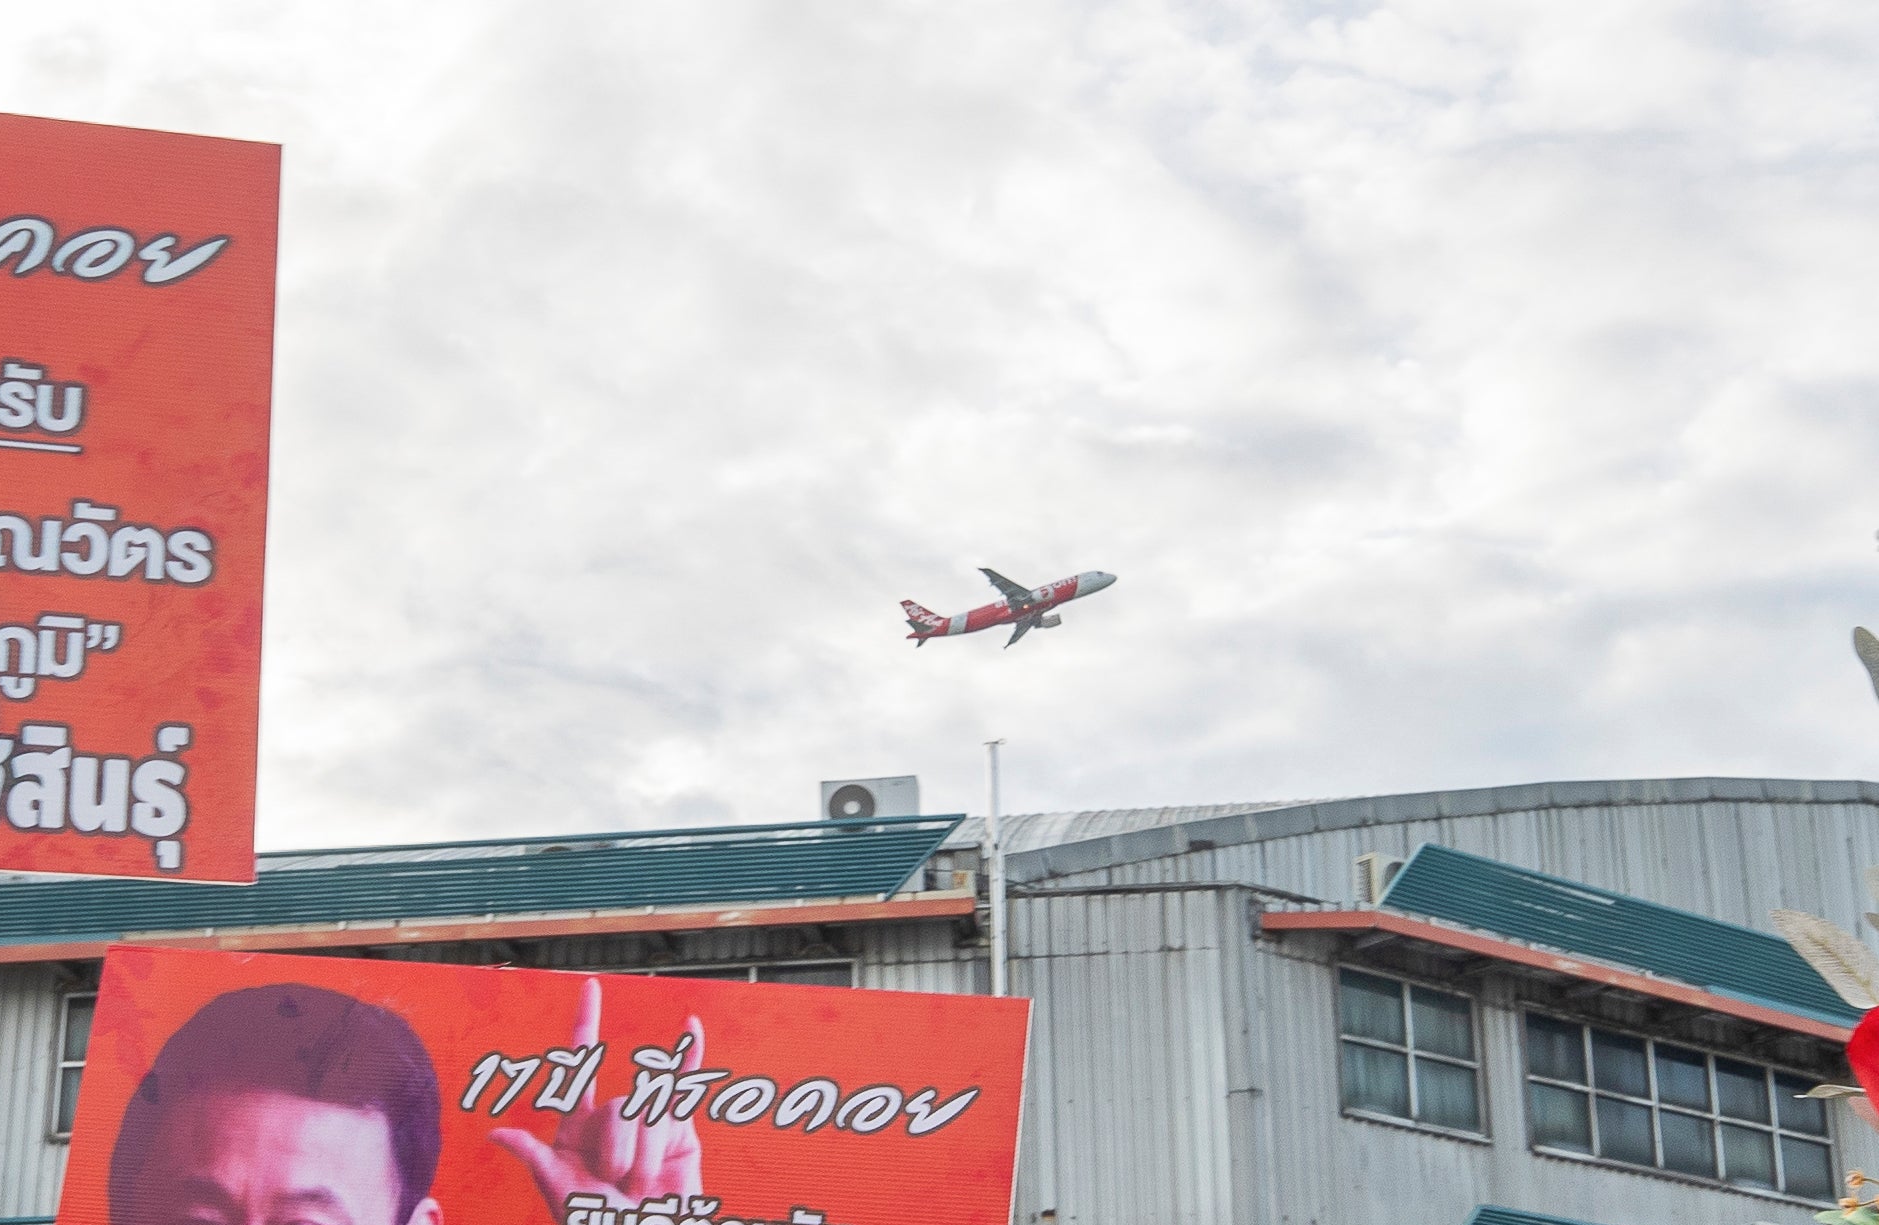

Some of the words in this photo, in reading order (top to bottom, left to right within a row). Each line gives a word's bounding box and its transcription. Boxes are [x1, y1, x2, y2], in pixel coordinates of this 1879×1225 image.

[461, 1045, 604, 1115] 17ปี
[622, 1036, 977, 1134] ที่รอคอย
